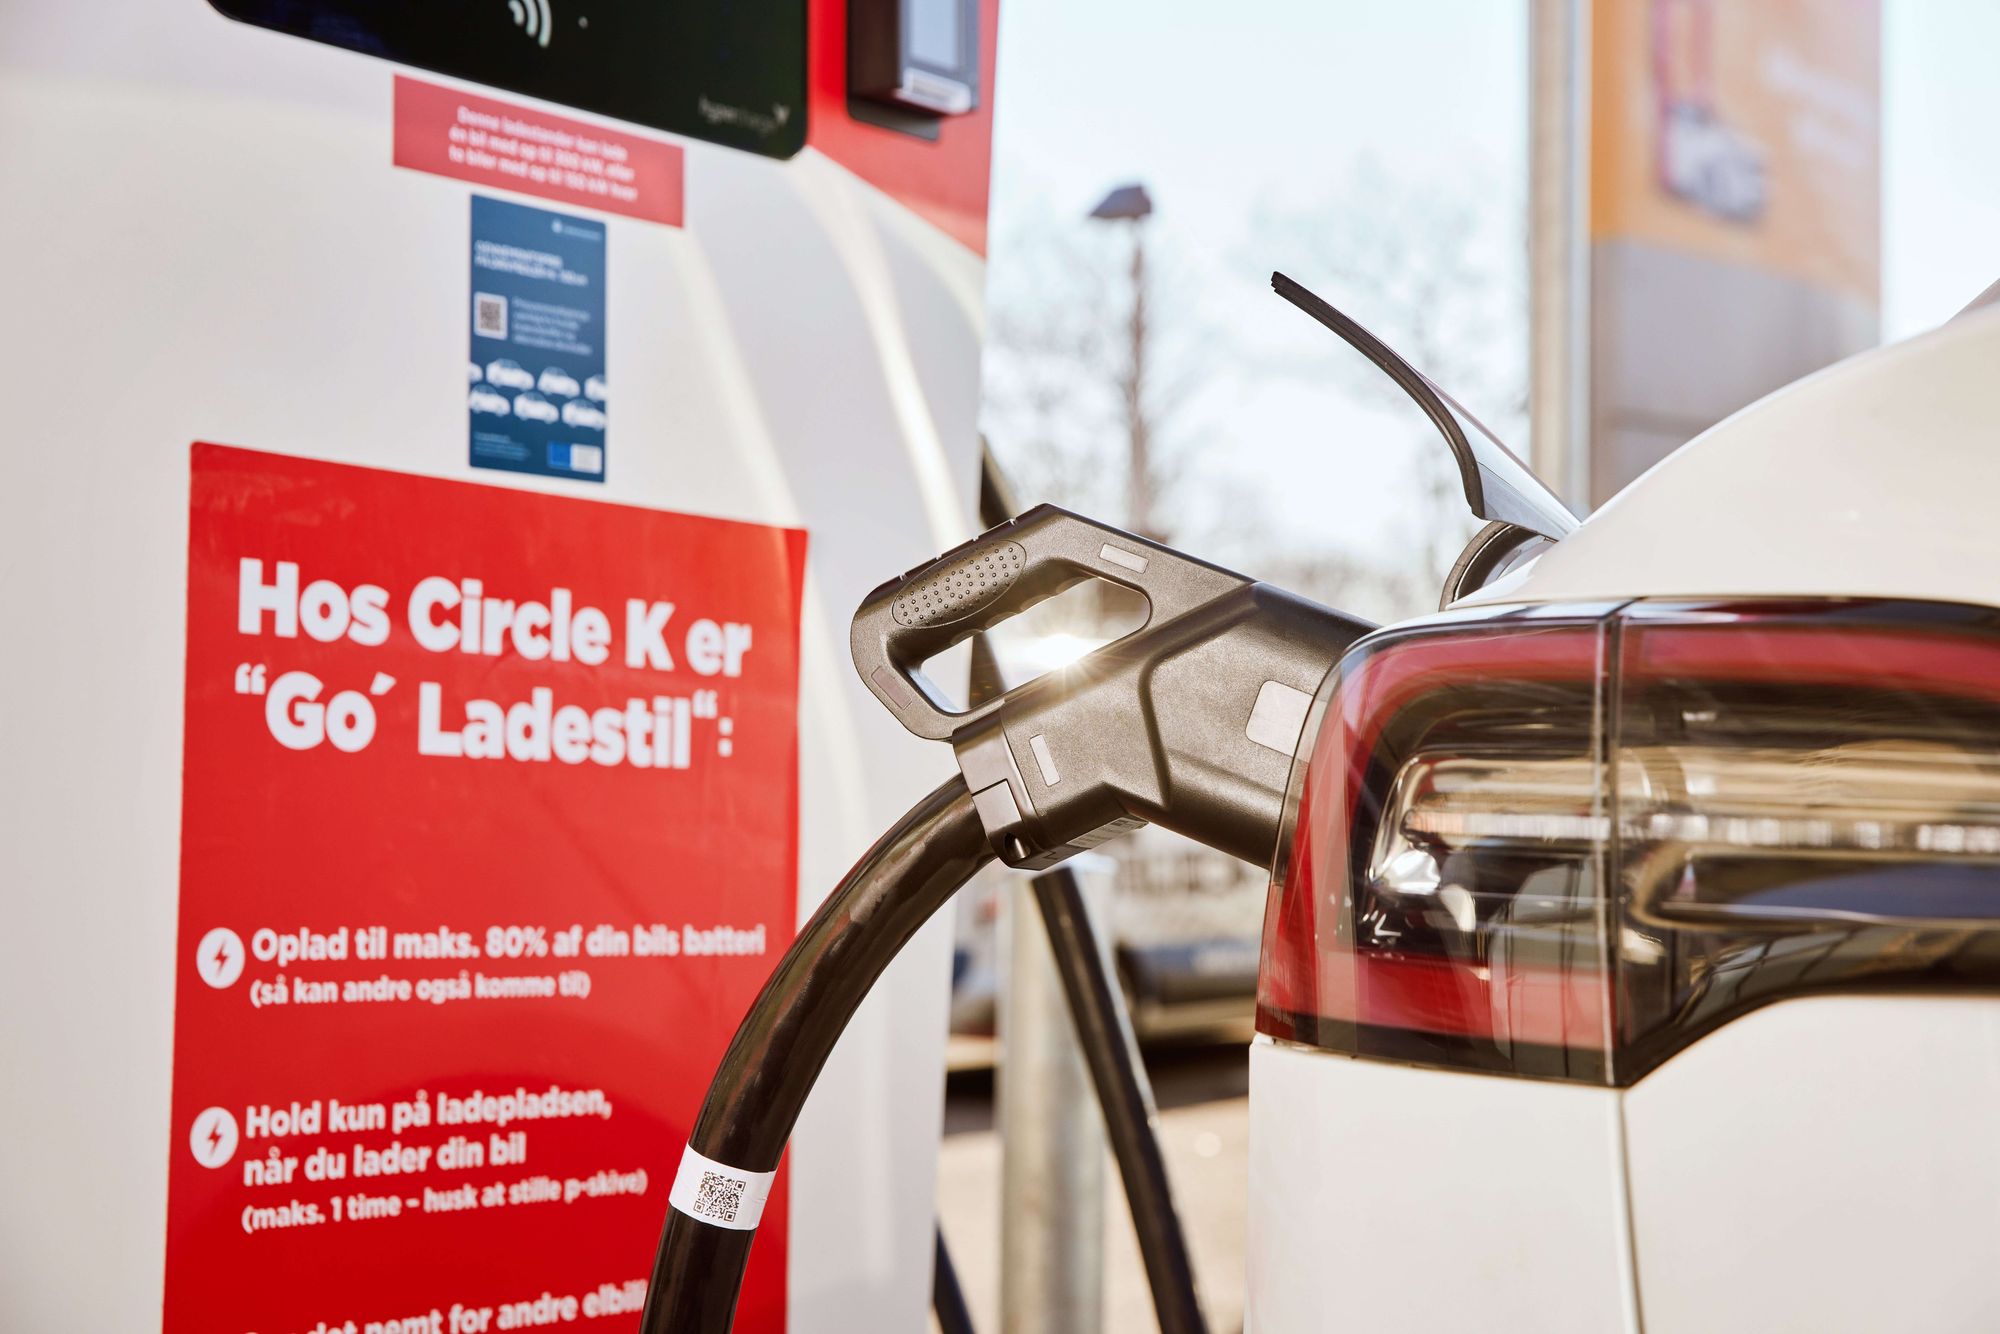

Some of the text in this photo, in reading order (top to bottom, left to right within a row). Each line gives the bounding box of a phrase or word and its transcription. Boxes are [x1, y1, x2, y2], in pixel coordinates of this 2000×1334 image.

[238, 557, 753, 678] Hos Circle K er
[251, 923, 766, 967] Oplad til maks. 80% af din bils batteri
[249, 970, 592, 1008] (så kan andre også komme til)
[245, 1085, 613, 1139] Hold kun på ladepladsen,
[243, 1131, 527, 1187] når du lader din bil
[241, 1199, 326, 1234] (maks.
[330, 1195, 342, 1222] 1
[347, 1193, 402, 1220] time
[423, 1183, 478, 1212] husk
[481, 1182, 506, 1207] at
[509, 1177, 562, 1204] stille
[564, 1169, 648, 1204] p-skive)
[448, 1303, 493, 1334] for
[496, 1292, 579, 1330] andre
